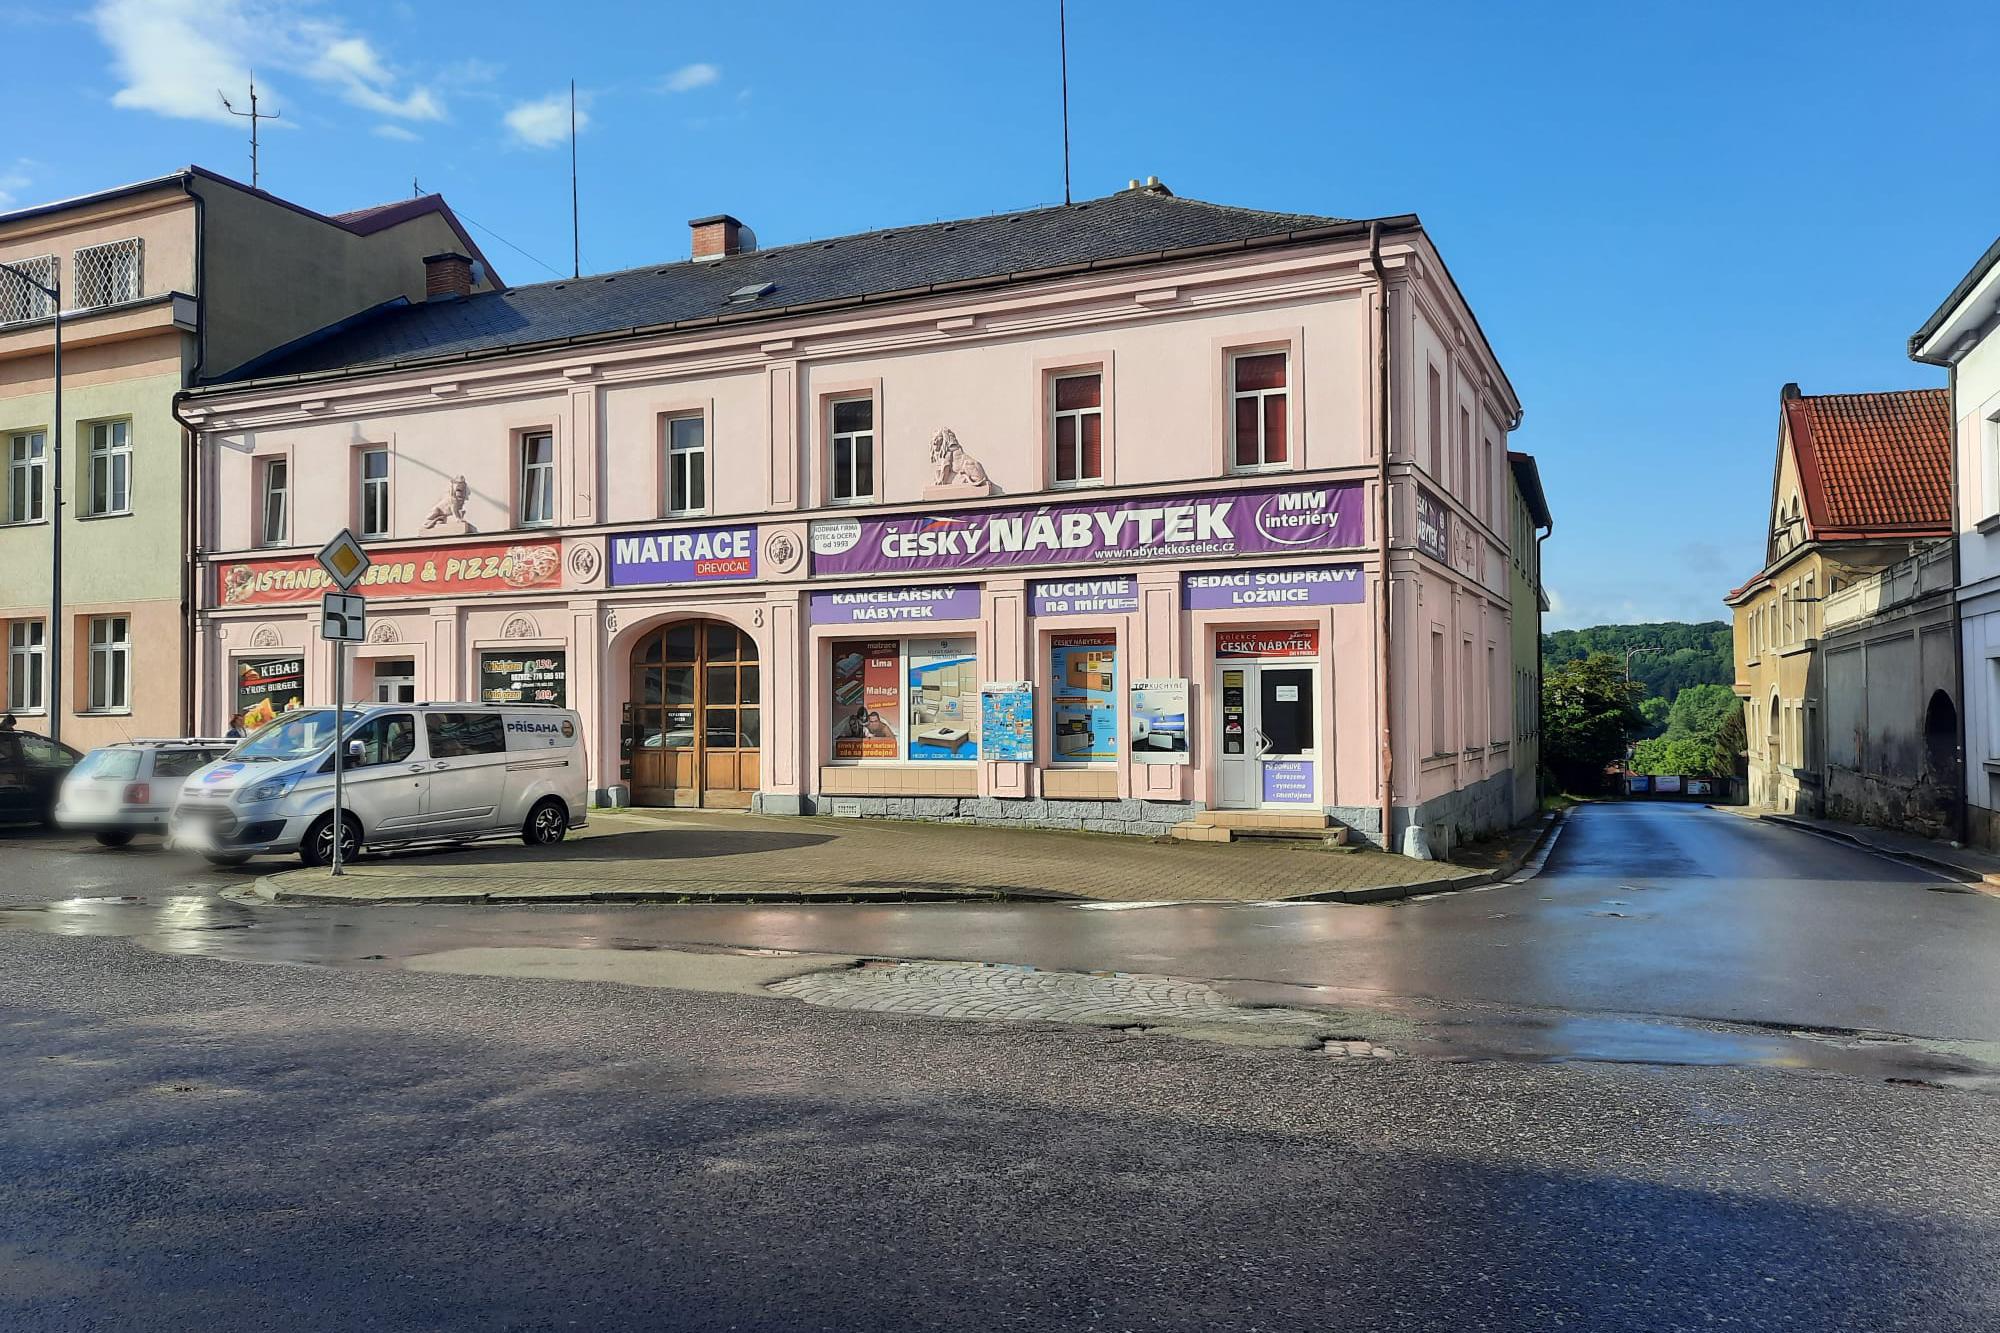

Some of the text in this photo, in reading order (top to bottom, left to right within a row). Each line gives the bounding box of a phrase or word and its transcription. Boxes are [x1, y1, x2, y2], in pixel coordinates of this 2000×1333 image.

[1278, 490, 1326, 511] MM
[1265, 511, 1339, 528] interiéry
[881, 503, 1235, 558] ČESKÝ NÁBYTEK
[616, 530, 751, 565] MATRACE
[1094, 541, 1235, 559] www.nabytekkostelec.cz
[255, 556, 513, 592] ISTANBU EBAB & PIZZA
[1187, 568, 1358, 588] SEDACÍ SOUPRAVY
[832, 585, 956, 604] KANCELÁŘSKÝ
[1035, 577, 1129, 597] KUCHYNĚ
[1232, 587, 1309, 603] LOŽNICE
[1045, 600, 1068, 611] na
[1074, 596, 1119, 611] míru
[753, 608, 764, 627] 8
[852, 605, 933, 620] NÁBYTEK
[1220, 639, 1312, 651] ČESKÝ NÁBYTEK
[261, 662, 299, 677] KEBAB
[871, 659, 892, 668] Lima
[267, 681, 297, 692] BURGER
[866, 686, 898, 696] Malaga
[507, 720, 559, 733] PŘÍSAHA
